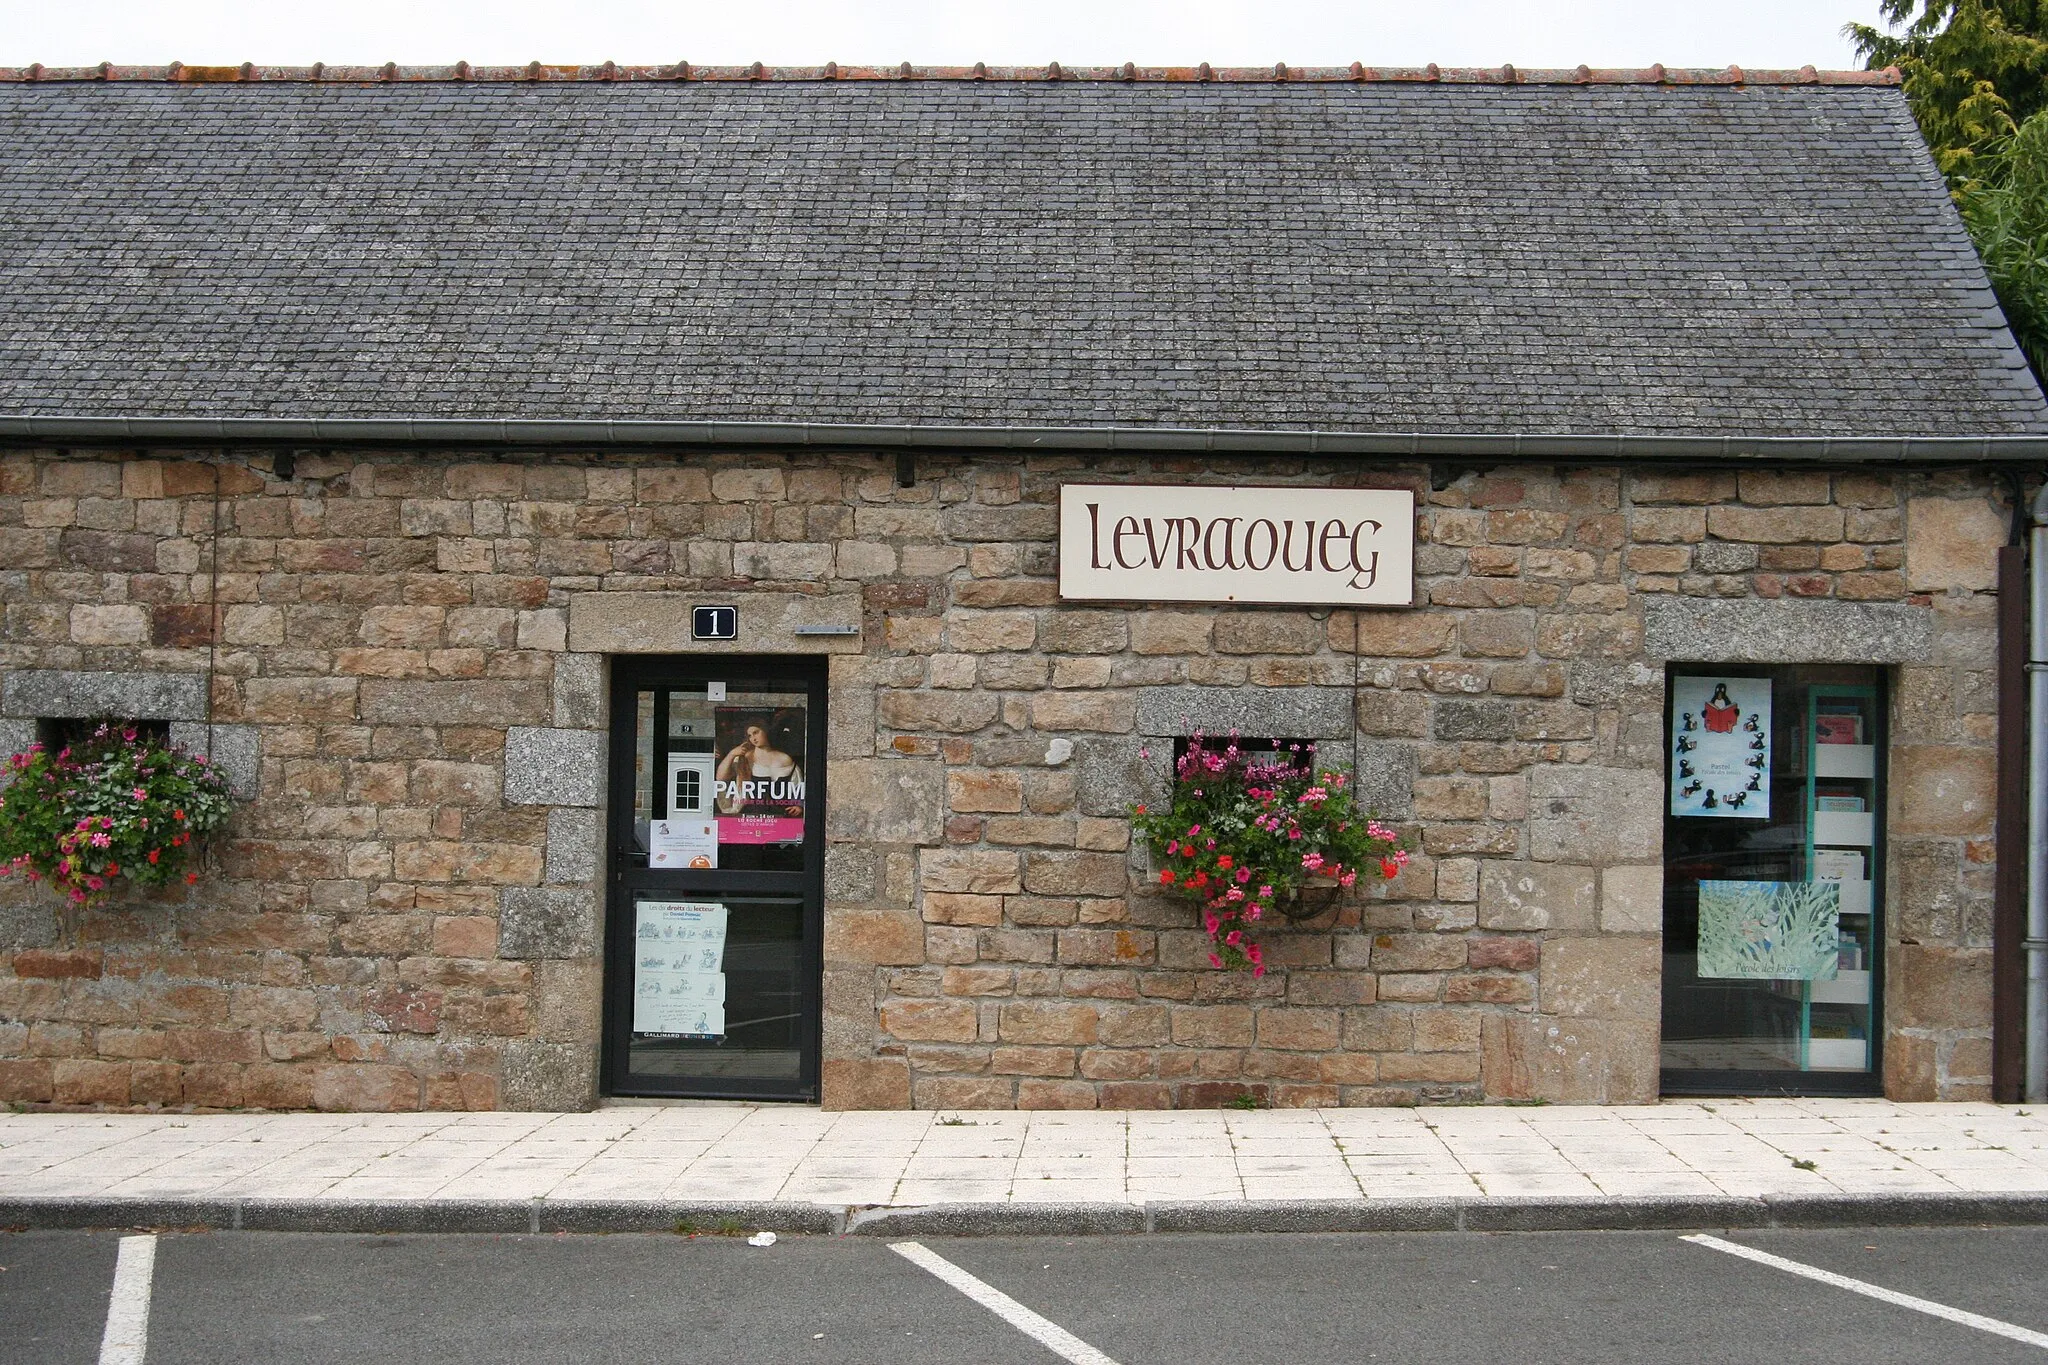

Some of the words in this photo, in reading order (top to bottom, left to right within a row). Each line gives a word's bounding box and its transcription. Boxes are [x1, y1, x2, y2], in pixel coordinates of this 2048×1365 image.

[1085, 503, 1382, 589] Levraoueg
[709, 610, 720, 635] 1
[712, 780, 806, 800] PARFUM
[1735, 962, 1759, 973] l'école
[1761, 962, 1774, 973] des
[1776, 962, 1800, 974] loisirs
